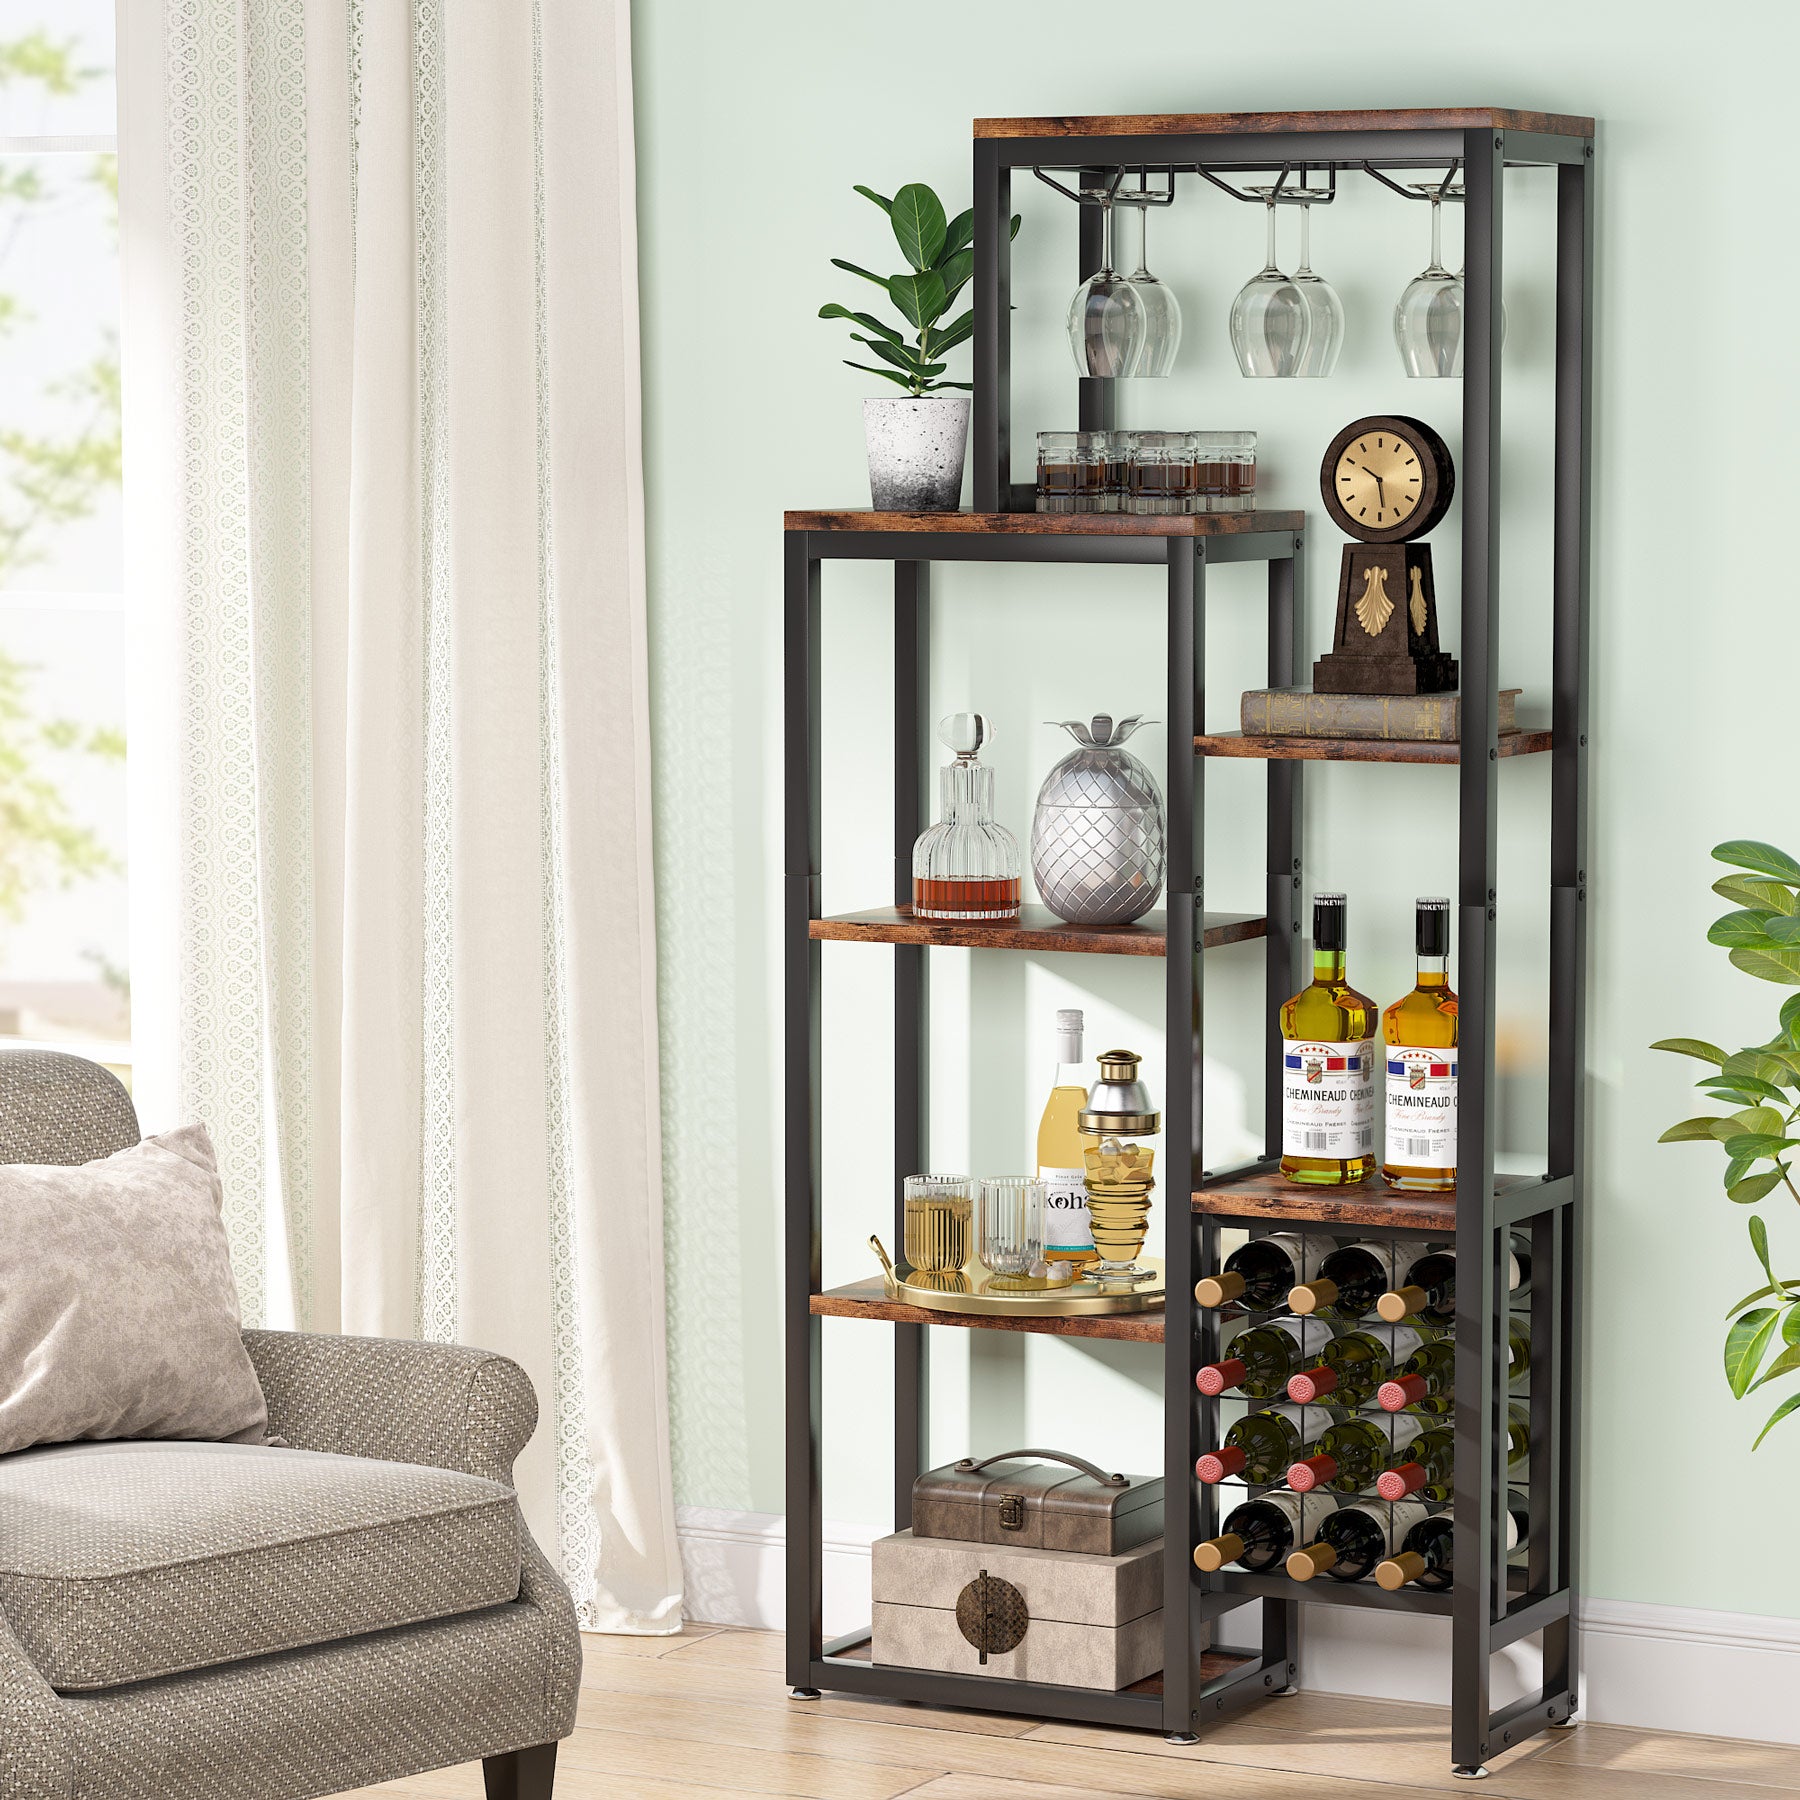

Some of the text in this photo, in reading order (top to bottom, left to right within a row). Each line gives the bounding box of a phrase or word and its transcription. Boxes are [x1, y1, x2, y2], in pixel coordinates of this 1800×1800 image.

[1286, 1087, 1347, 1102] CHEMINEAUD
[1389, 1093, 1451, 1108] CHEMINEAUD
[1308, 1103, 1343, 1117] Brandy
[1411, 1109, 1446, 1123] Brandy
